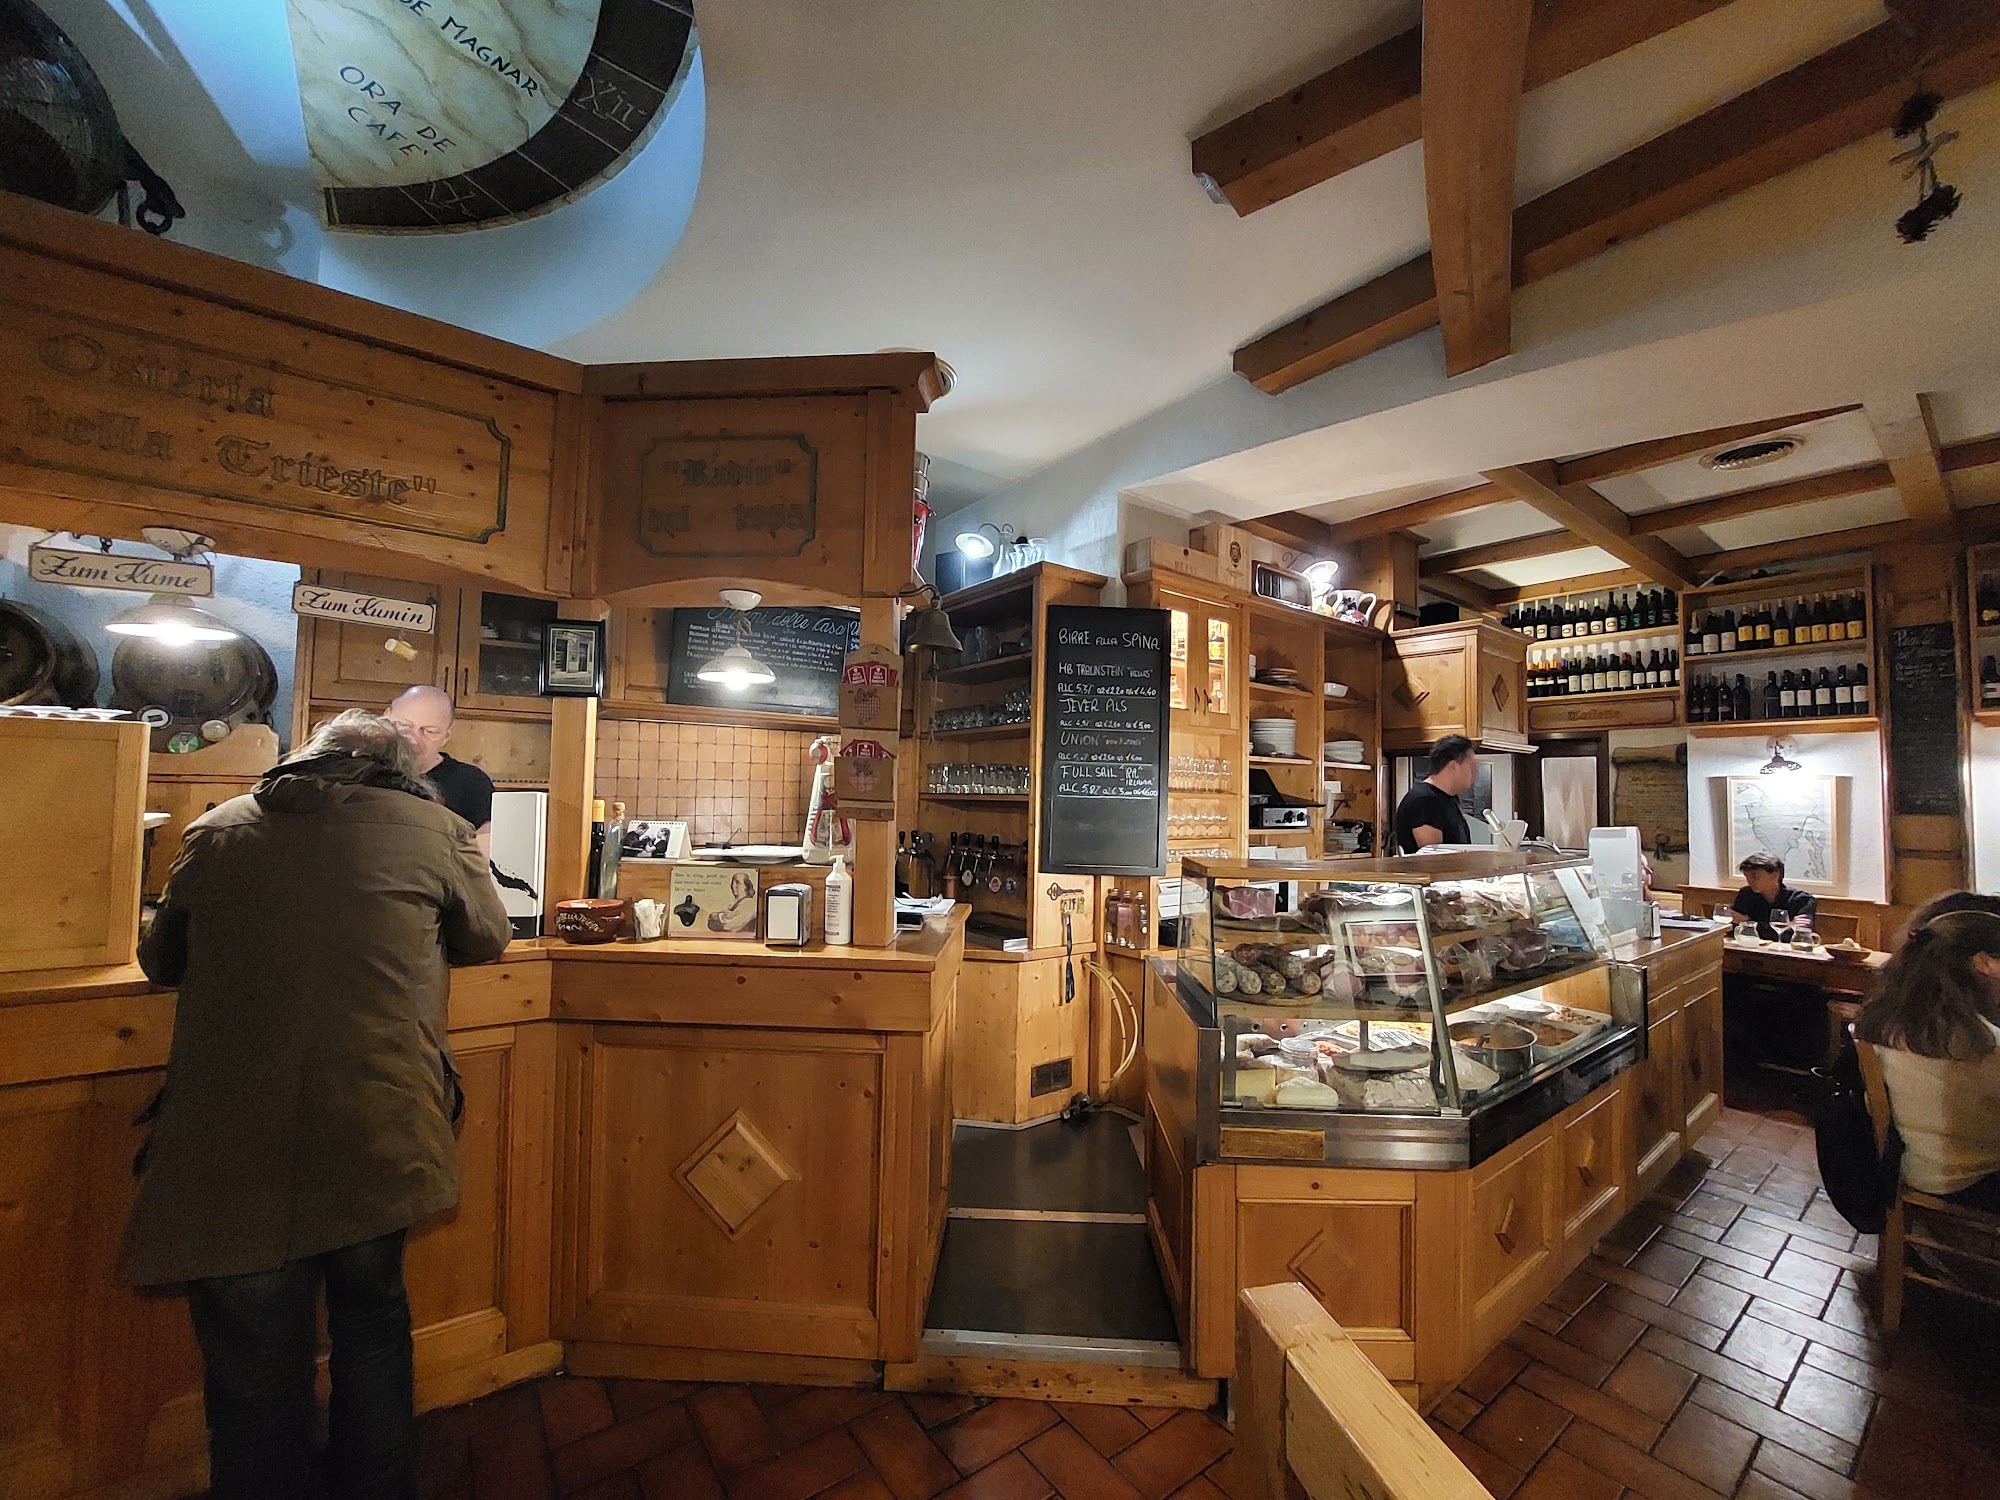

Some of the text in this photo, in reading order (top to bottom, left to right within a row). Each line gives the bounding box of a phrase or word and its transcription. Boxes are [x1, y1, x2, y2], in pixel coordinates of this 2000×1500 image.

[440, 15, 539, 98] MAGNAR
[339, 66, 457, 154] ORA DE
[41, 555, 199, 589] Zum Kume
[299, 588, 425, 625] Zum Kumin
[1058, 627, 1091, 646] BIRRE
[1058, 661, 1074, 675] HB
[1059, 697, 1099, 714] JEVER
[1060, 765, 1093, 779] FULL
